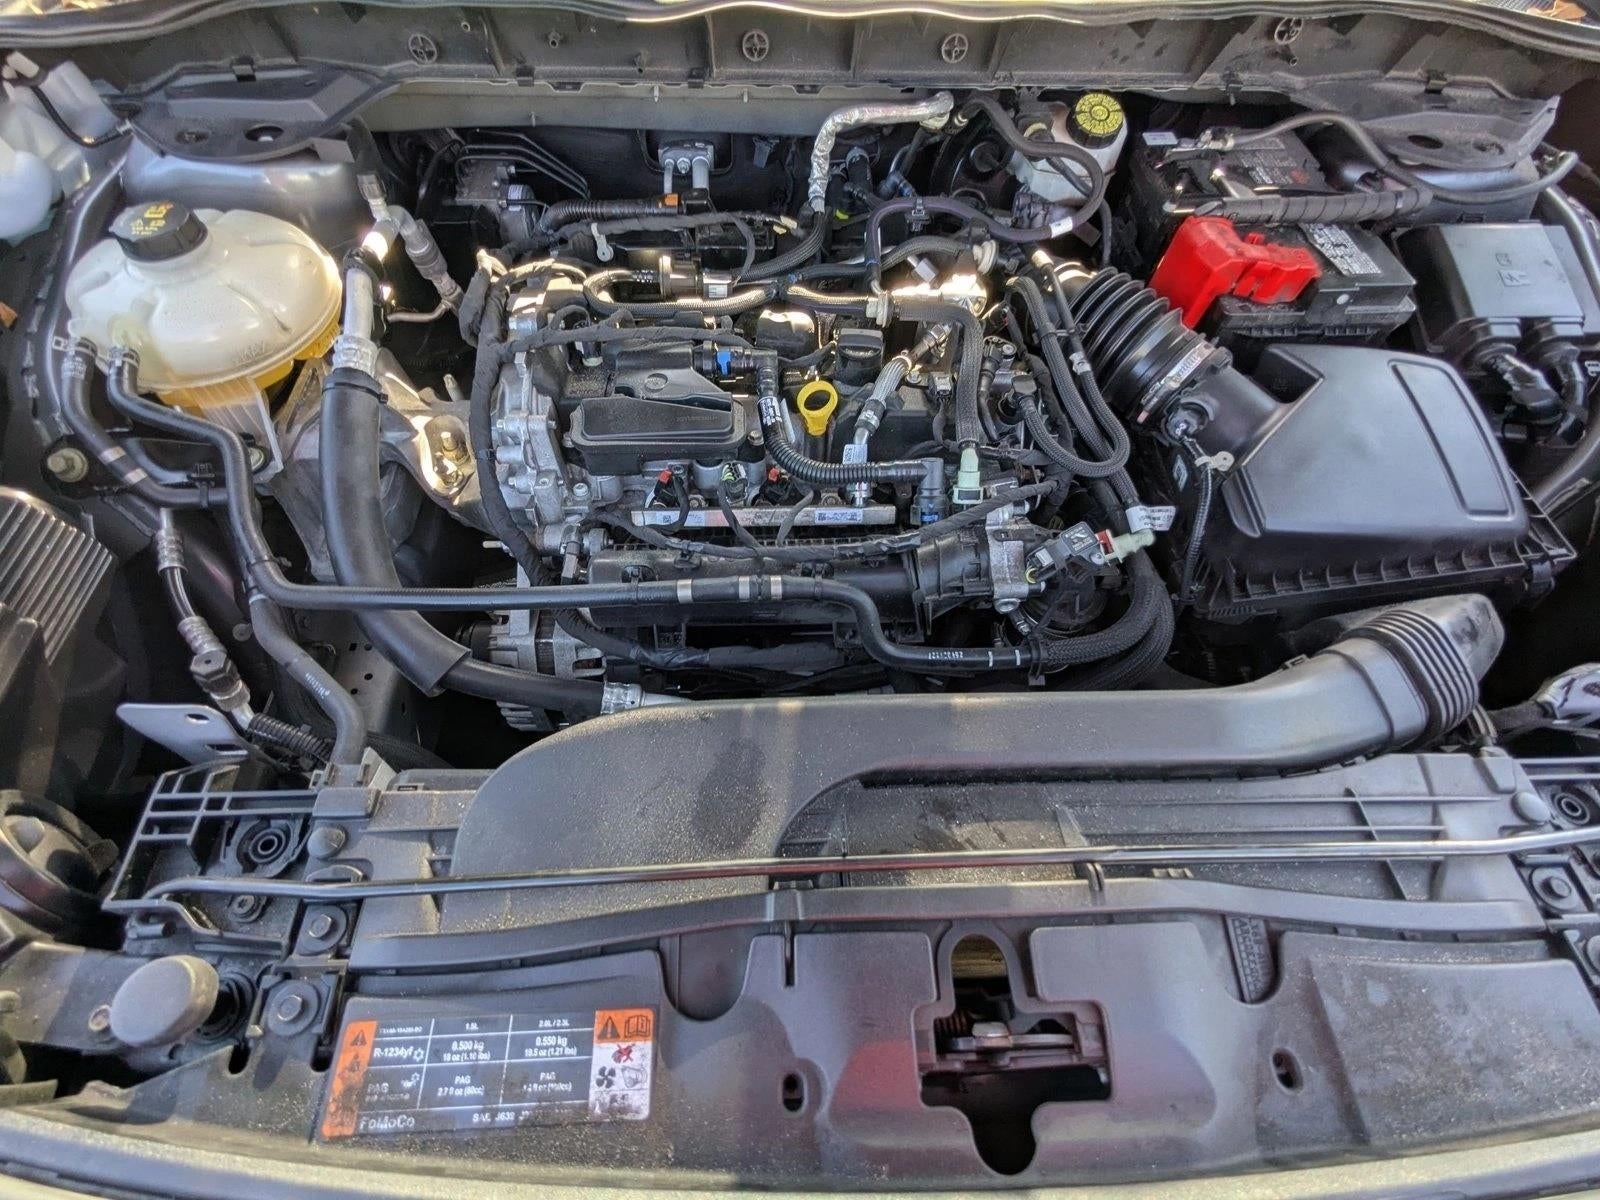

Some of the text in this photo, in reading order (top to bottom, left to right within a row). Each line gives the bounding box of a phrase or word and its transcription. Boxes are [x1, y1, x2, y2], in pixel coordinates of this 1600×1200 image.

[474, 1039, 484, 1051] kg
[557, 1036, 568, 1047] kg
[374, 1046, 414, 1058] R-1234yf
[454, 1075, 472, 1084] PAG
[540, 1072, 556, 1080] PAG
[360, 1115, 415, 1129] FoMoCo
